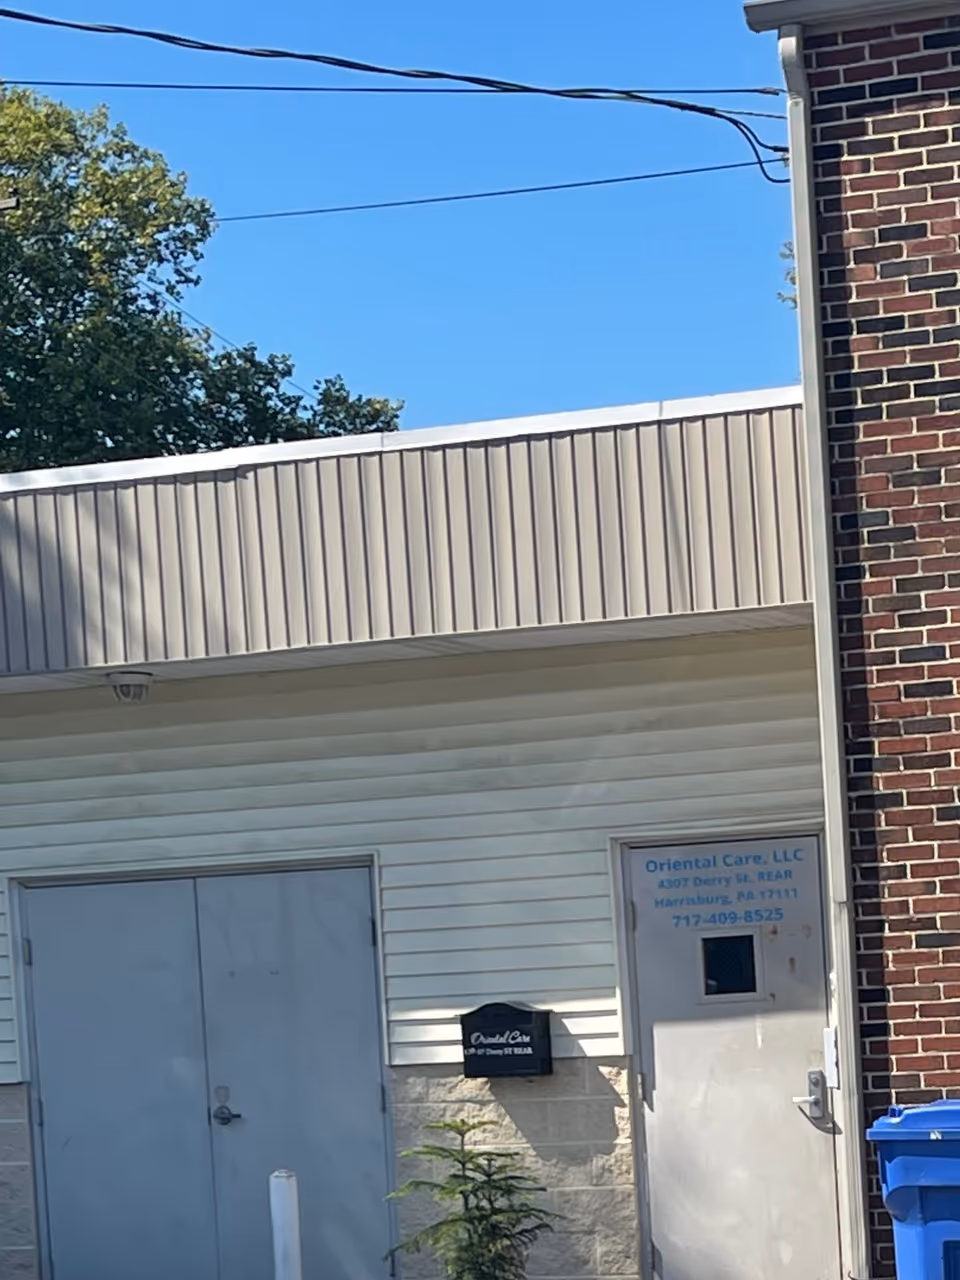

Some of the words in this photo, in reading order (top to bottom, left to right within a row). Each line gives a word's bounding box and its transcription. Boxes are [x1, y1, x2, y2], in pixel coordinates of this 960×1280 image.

[645, 855, 717, 873] Oriental
[772, 848, 805, 863] LLC
[657, 877, 690, 889] 4307
[692, 873, 732, 888] Derry
[757, 869, 793, 882] REAR
[654, 892, 733, 909] Harrisburg,
[736, 890, 755, 902] PA
[759, 887, 798, 900] 17111
[672, 907, 784, 929] 717-409-8525
[508, 1030, 531, 1044] Care
